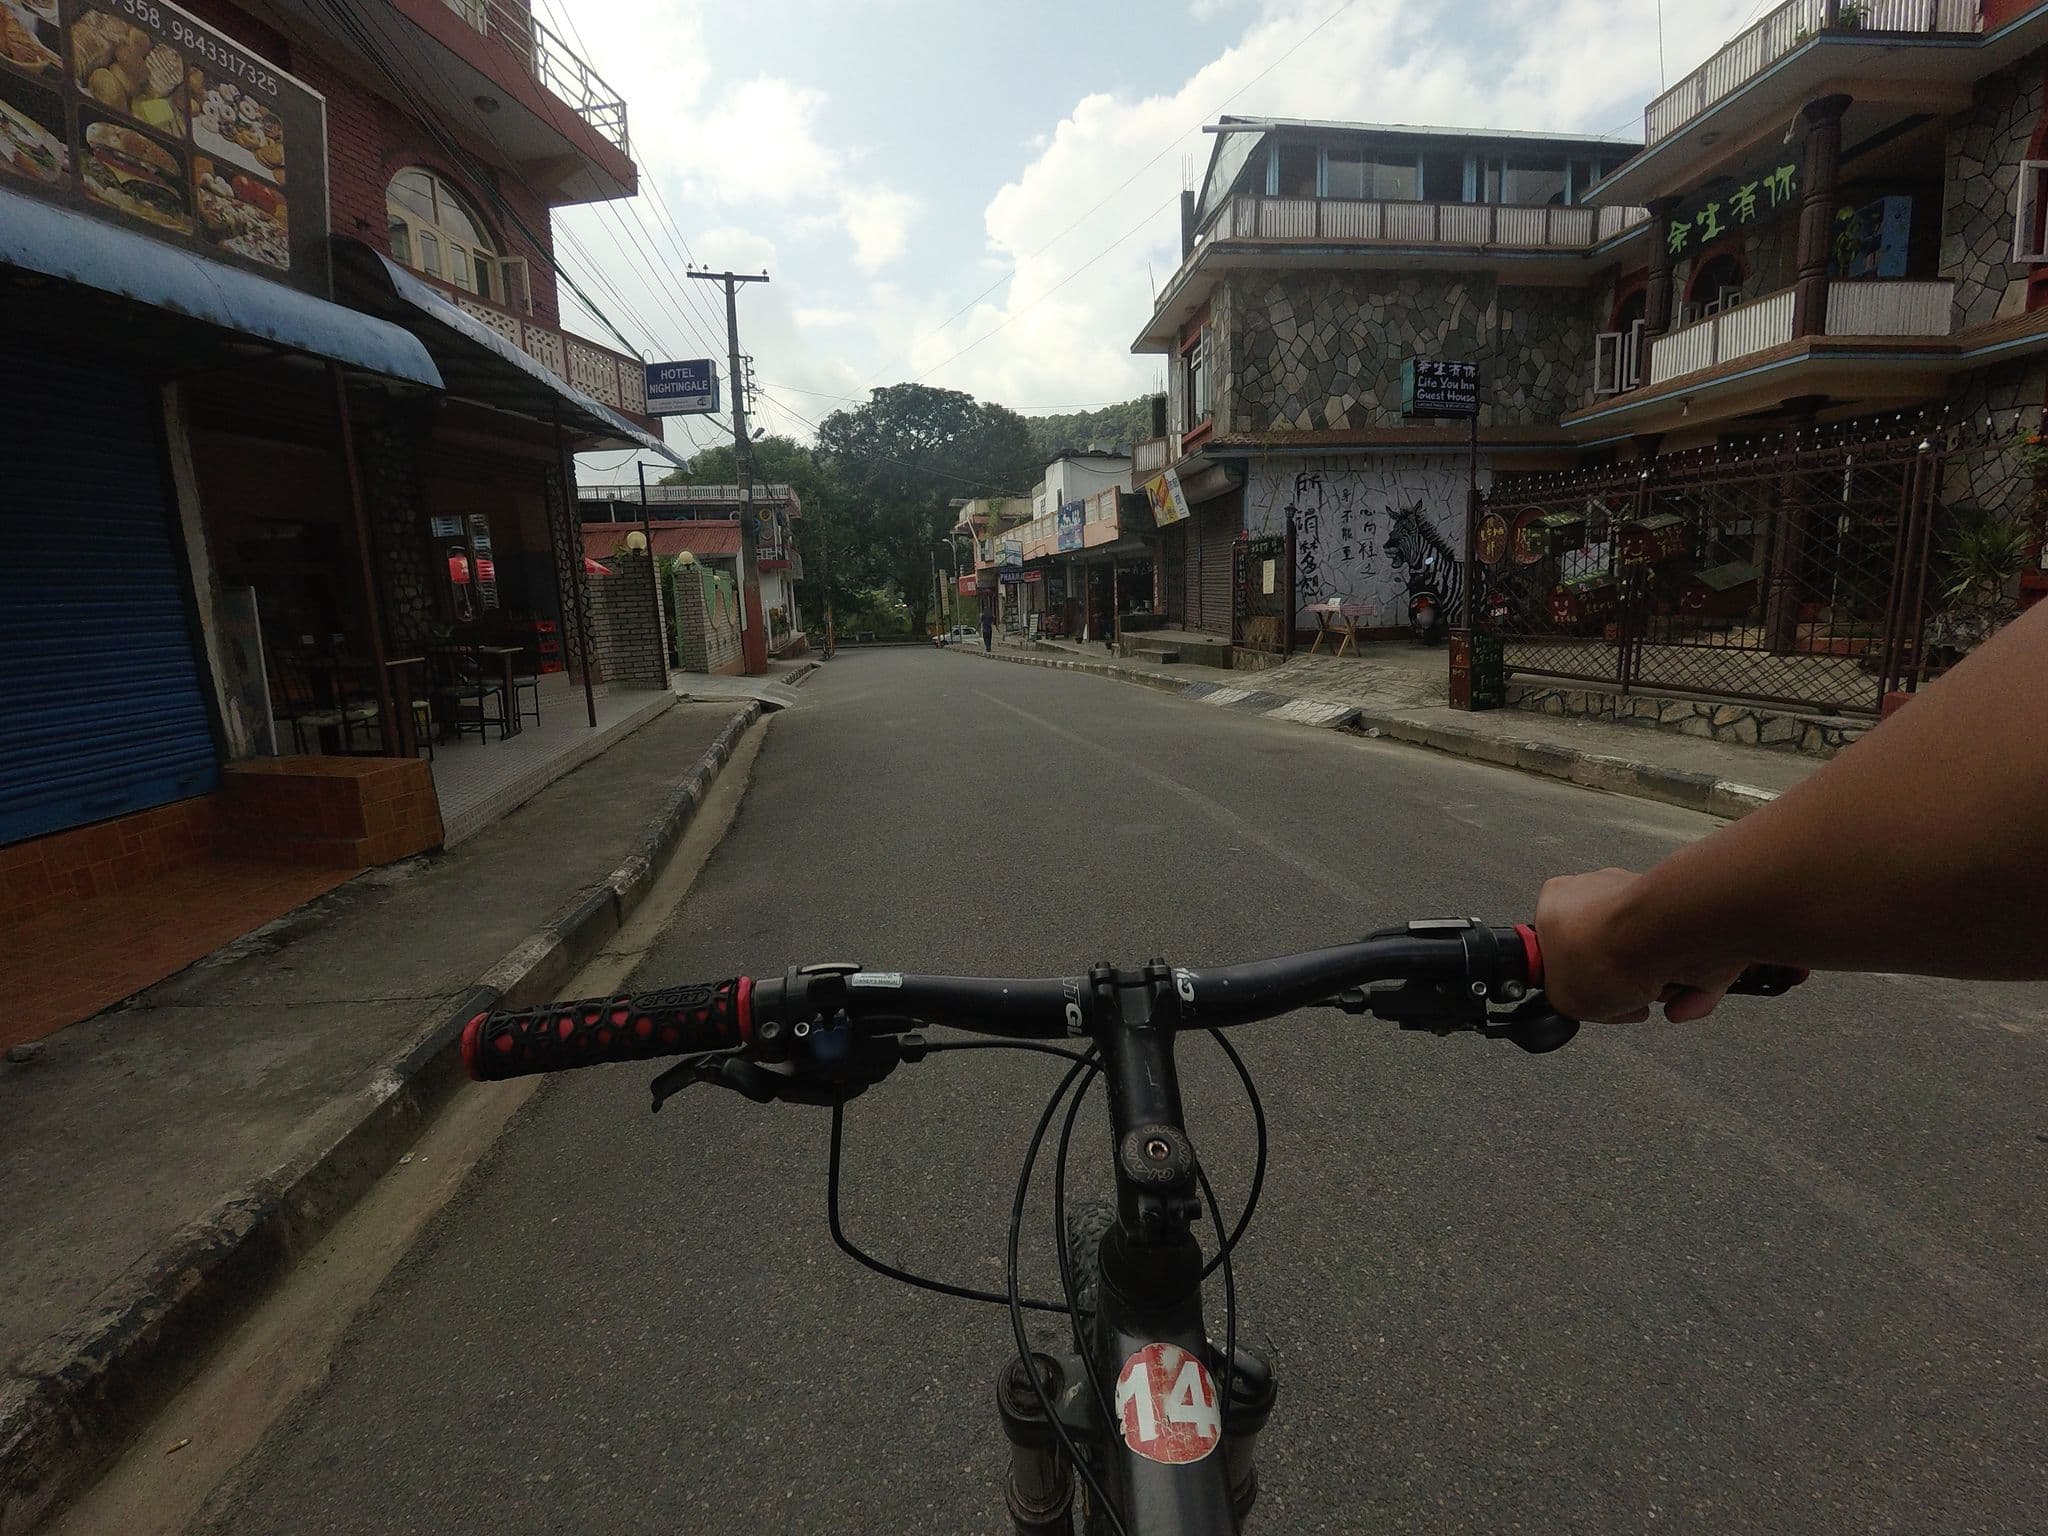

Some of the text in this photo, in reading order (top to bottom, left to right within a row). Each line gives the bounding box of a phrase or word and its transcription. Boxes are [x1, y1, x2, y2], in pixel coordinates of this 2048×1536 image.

[661, 367, 695, 380] HOTEL
[649, 380, 708, 395] NIGHTINGALE
[1440, 377, 1459, 390] You
[1460, 379, 1476, 390] Inn
[1417, 388, 1476, 402] Guest House
[1116, 1361, 1219, 1442] 14
